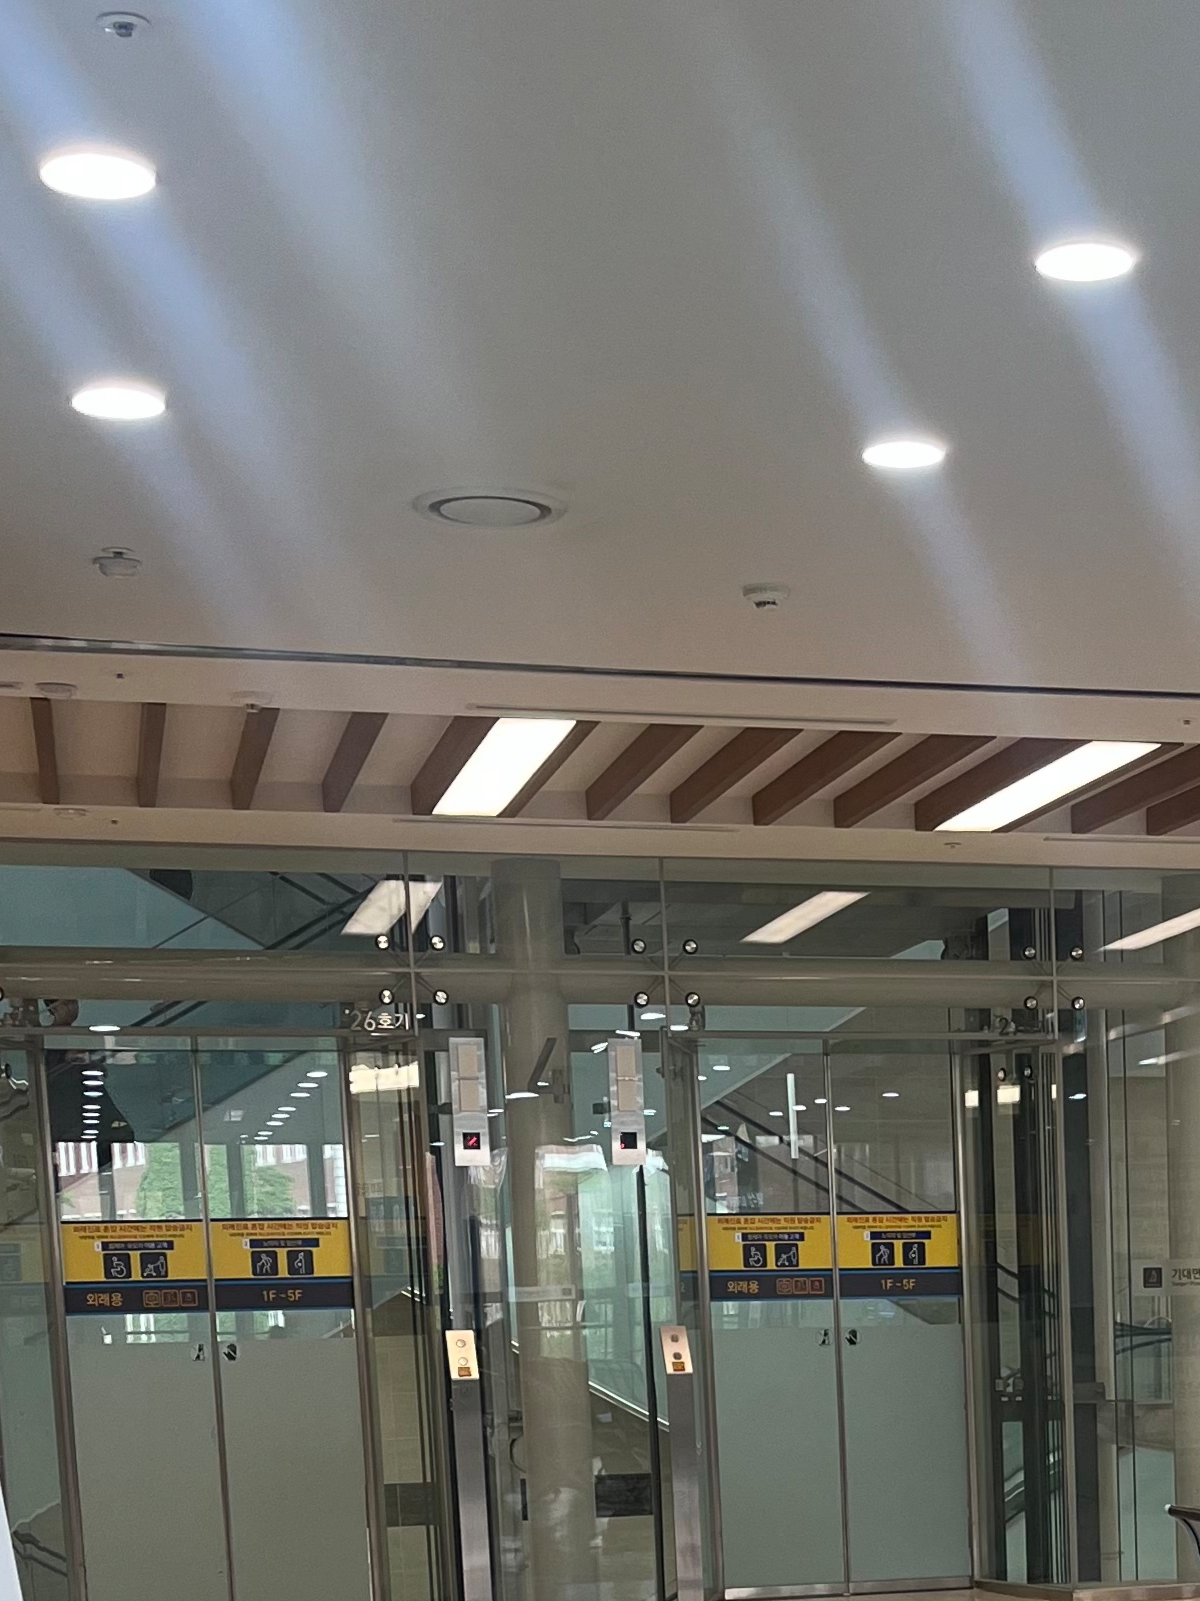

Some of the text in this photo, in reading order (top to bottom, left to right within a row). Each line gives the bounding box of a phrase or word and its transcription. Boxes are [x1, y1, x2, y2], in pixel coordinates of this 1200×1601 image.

[350, 1010, 409, 1031] 26호기
[727, 1281, 759, 1294] 외래용
[86, 1292, 123, 1307] 외래용
